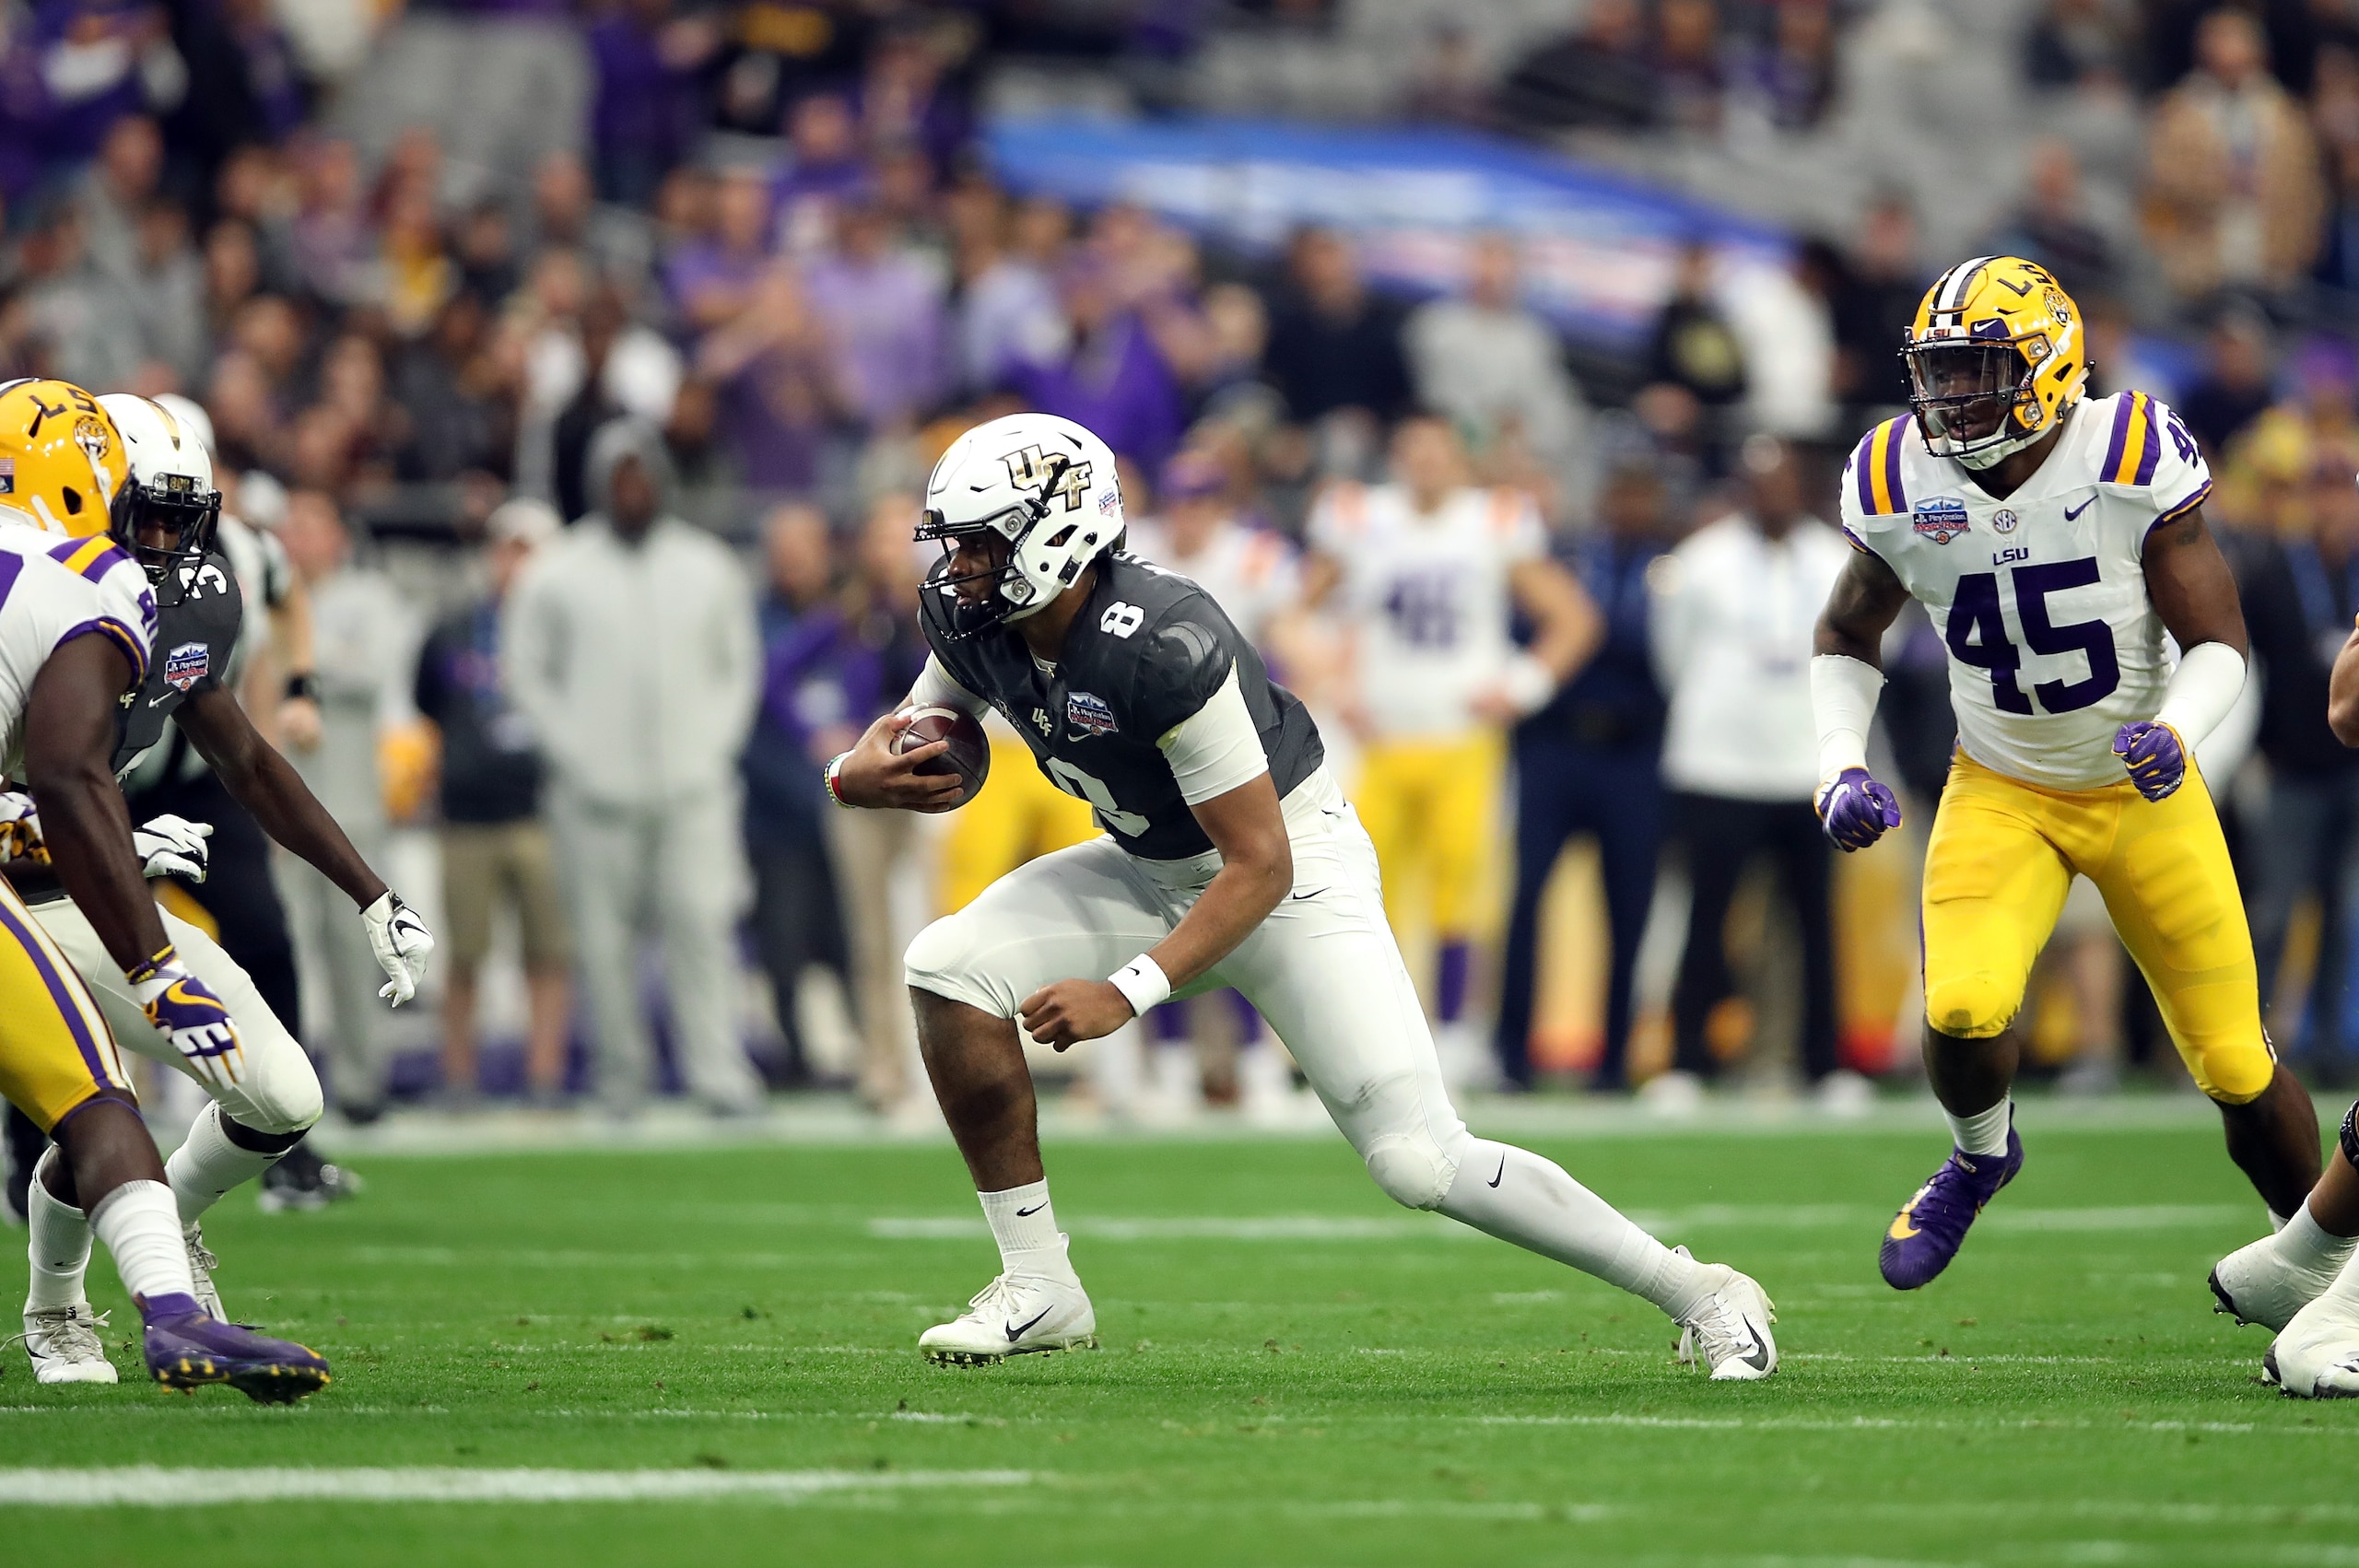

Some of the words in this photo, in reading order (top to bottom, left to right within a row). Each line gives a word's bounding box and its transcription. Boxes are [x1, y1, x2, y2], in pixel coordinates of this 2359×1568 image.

[1994, 509, 2016, 533] SEC
[1992, 546, 2029, 567] LSU
[1099, 600, 1146, 639] 8
[1945, 556, 2120, 716] 45
[1031, 708, 1053, 737] UCF
